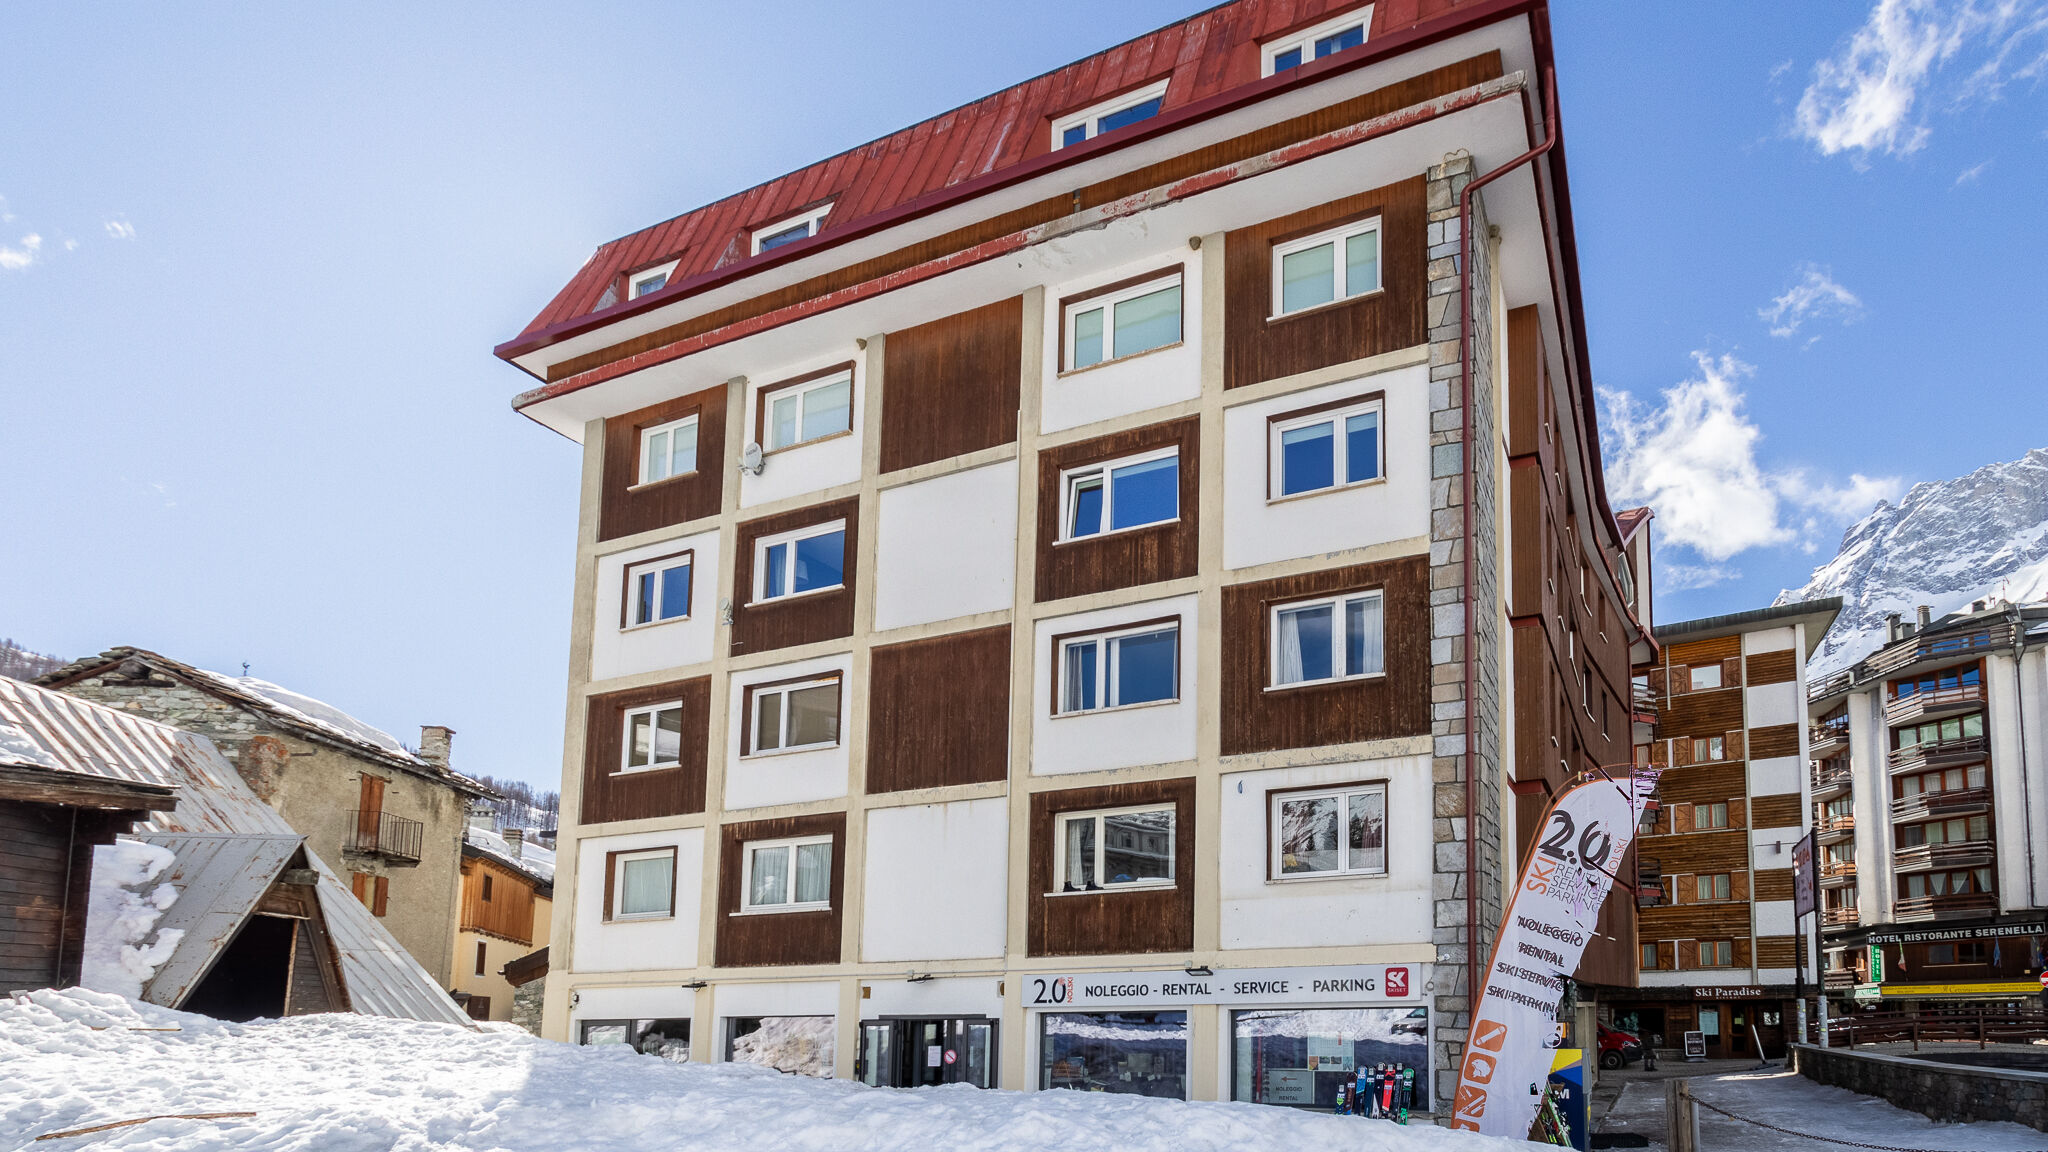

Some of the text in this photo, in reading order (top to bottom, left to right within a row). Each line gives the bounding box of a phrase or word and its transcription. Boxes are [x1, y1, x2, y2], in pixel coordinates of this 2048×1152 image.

[1538, 810, 1611, 870] 2.0
[1526, 856, 1557, 895] SKI
[1555, 863, 1608, 892] RENTAL
[1517, 915, 1583, 947] NOLEGGIO
[1868, 925, 2043, 944] HOTEL RISTORANTE SERENELLA
[1518, 942, 1564, 968] RENTAL
[1033, 978, 1066, 1004] 2.0
[1085, 984, 1149, 998] NOLEGGIO
[1162, 983, 1212, 996] RENTAL
[1233, 980, 1289, 994] SERVICE
[1313, 978, 1375, 993] PARKING
[1695, 987, 1761, 997] Ski Paradise
